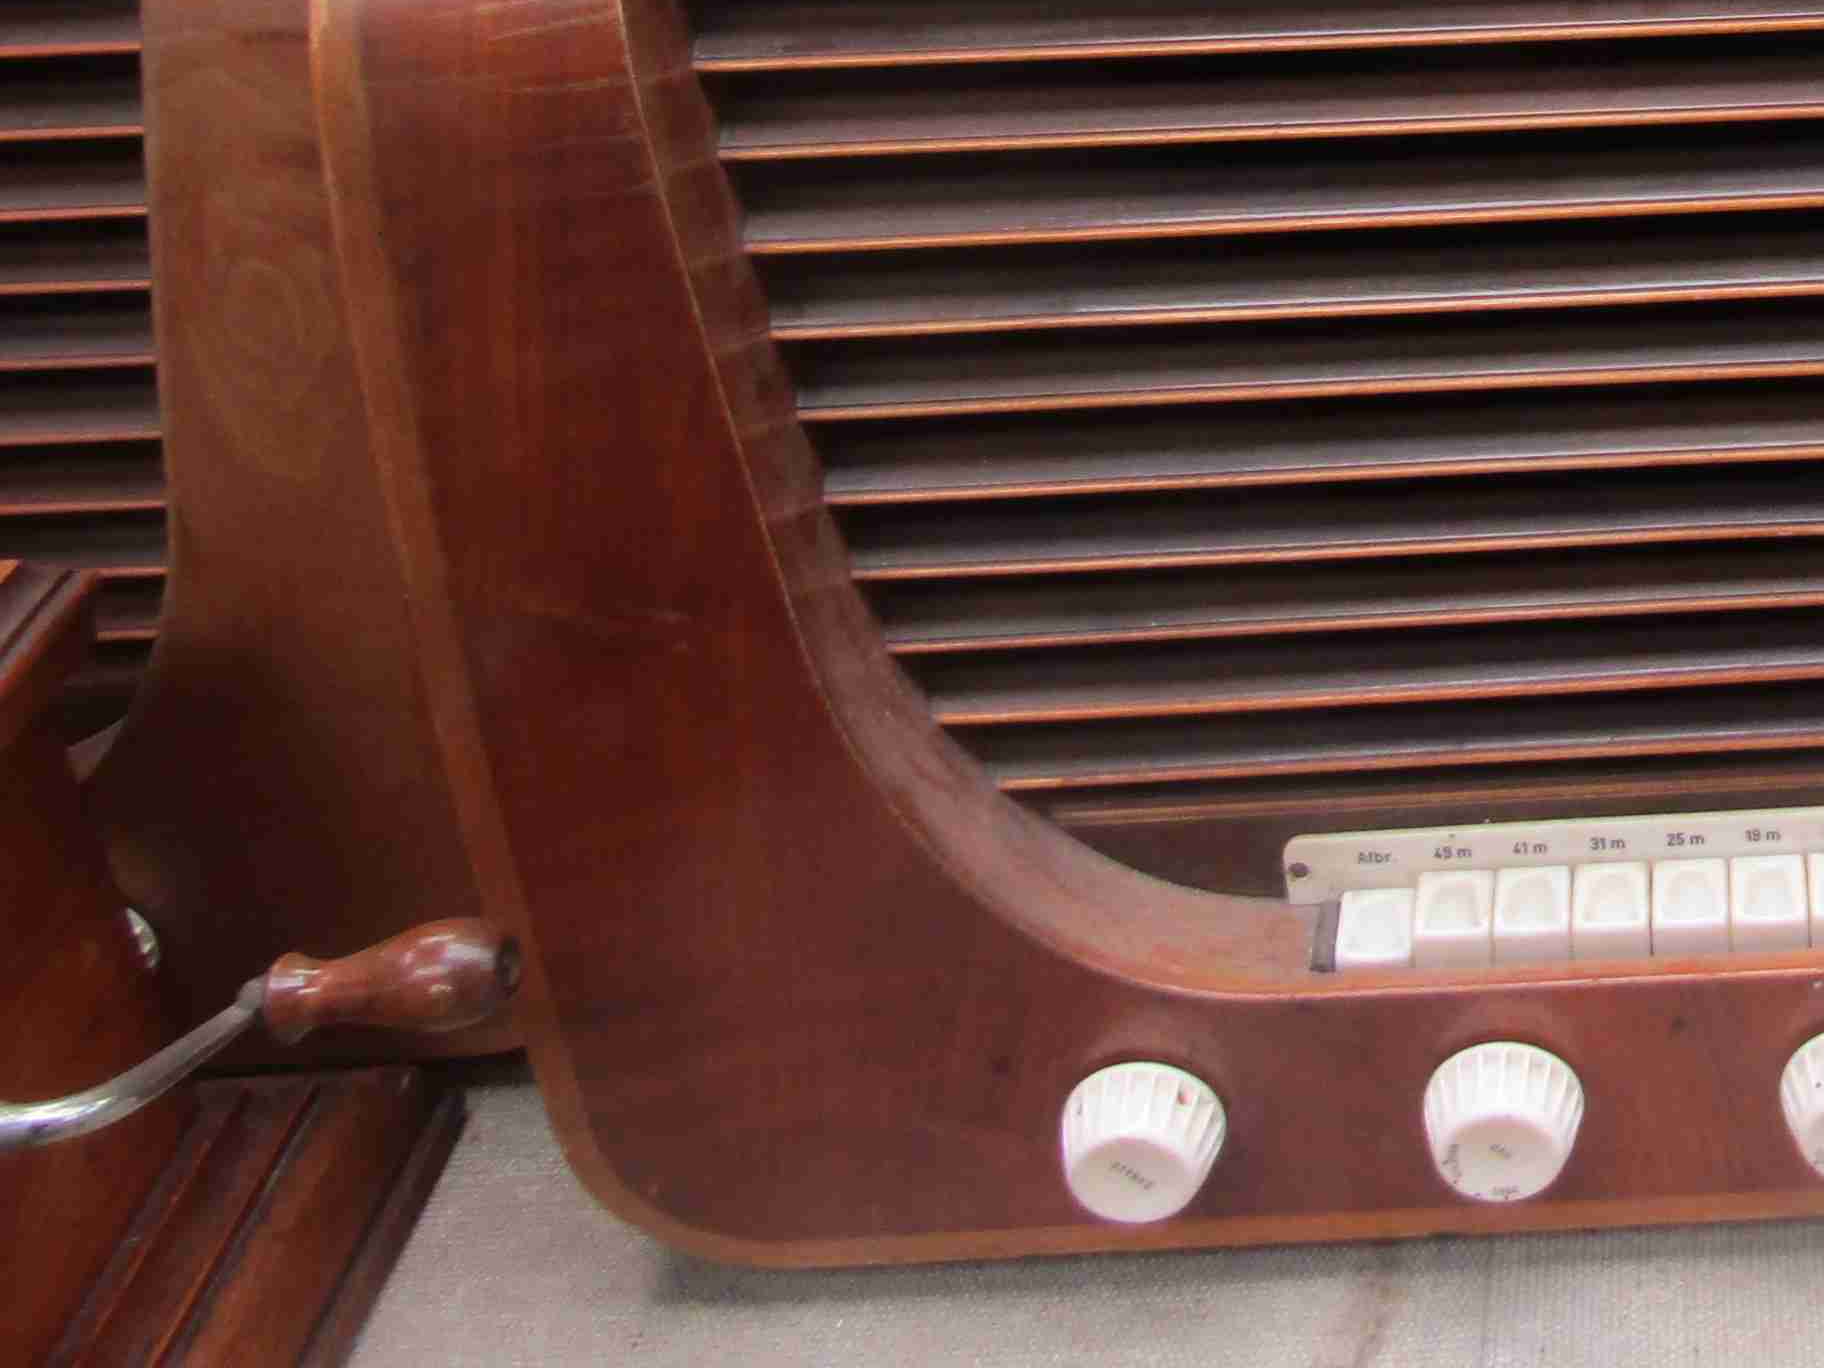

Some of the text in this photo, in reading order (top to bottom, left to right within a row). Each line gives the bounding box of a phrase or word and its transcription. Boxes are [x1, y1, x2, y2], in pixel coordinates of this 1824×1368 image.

[1456, 847, 1472, 860] m
[1513, 840, 1530, 855] 41
[1533, 842, 1548, 854] m
[1589, 837, 1607, 852] 31
[1610, 838, 1626, 851] m
[1666, 833, 1686, 848] 25
[1689, 834, 1705, 846] m
[1765, 829, 1781, 842] m
